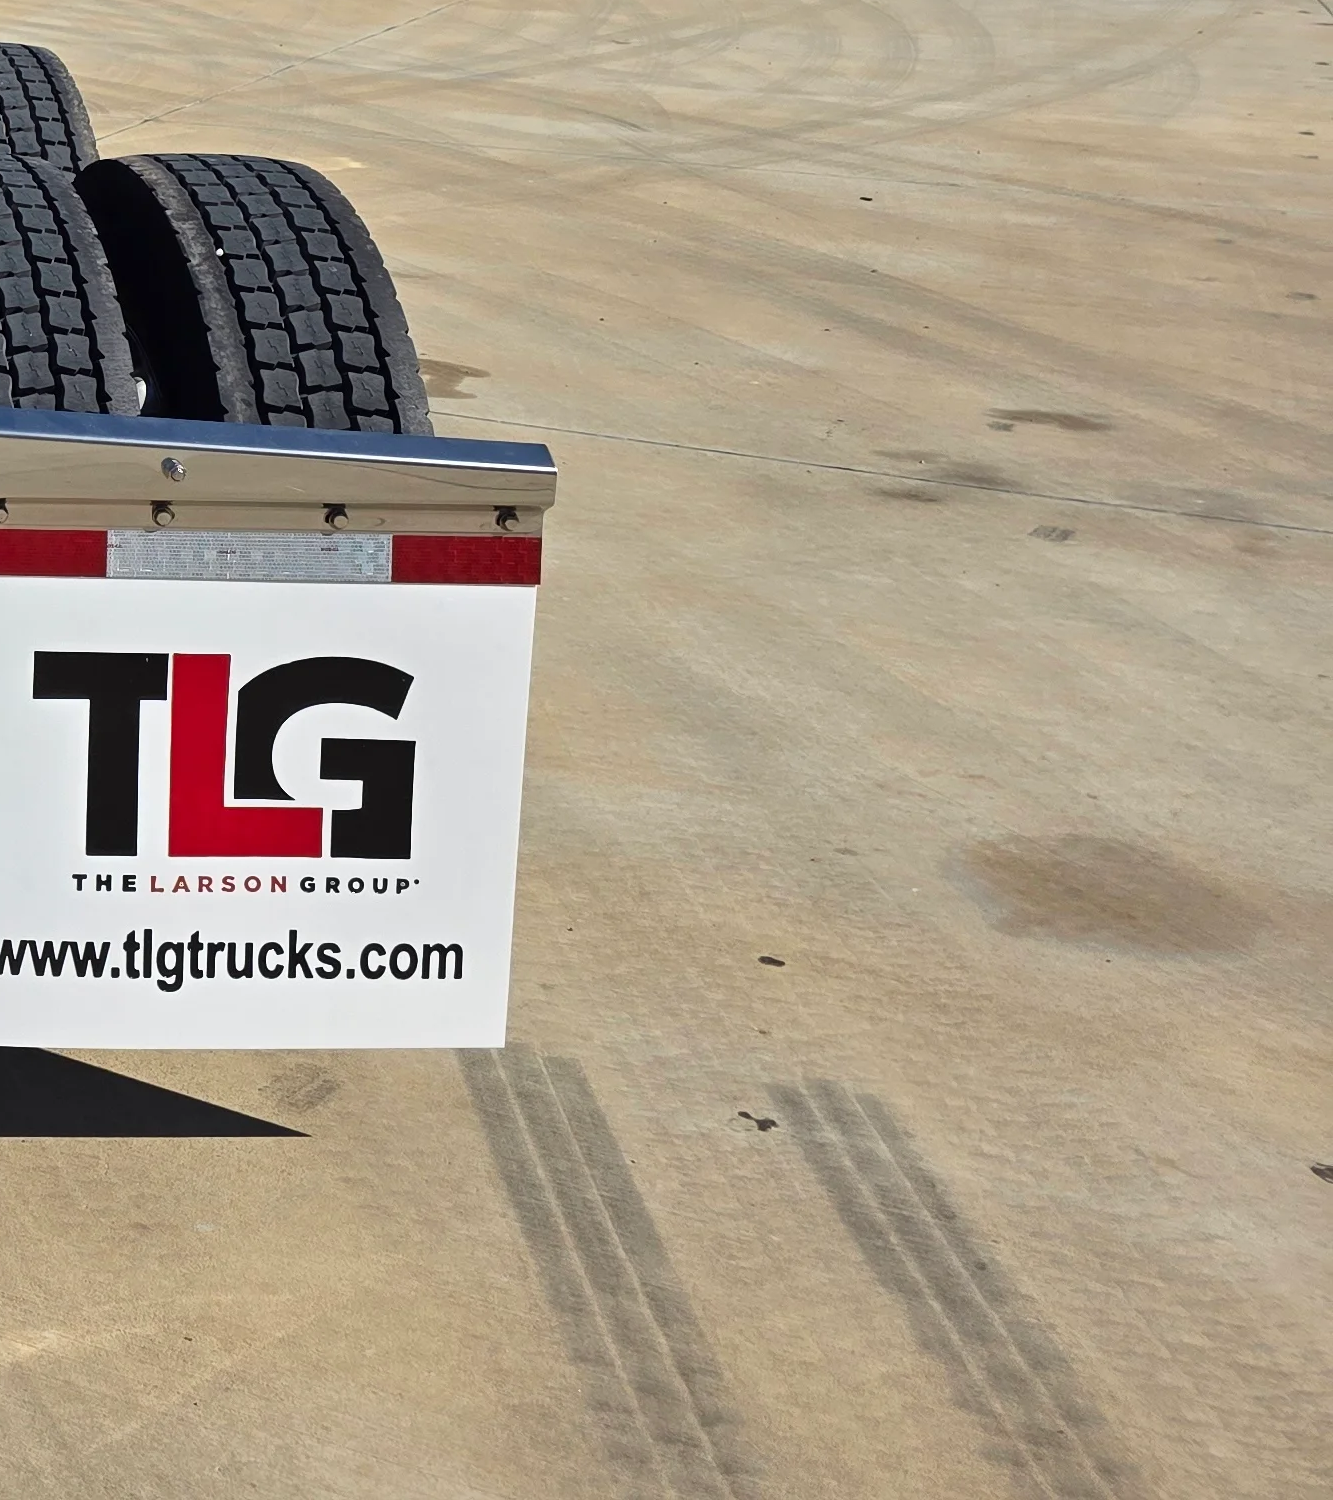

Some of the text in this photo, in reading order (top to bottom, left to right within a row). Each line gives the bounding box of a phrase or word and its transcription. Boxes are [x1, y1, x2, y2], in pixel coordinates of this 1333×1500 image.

[32, 650, 417, 860] TLG
[71, 873, 410, 895] THE LARSON GROUP
